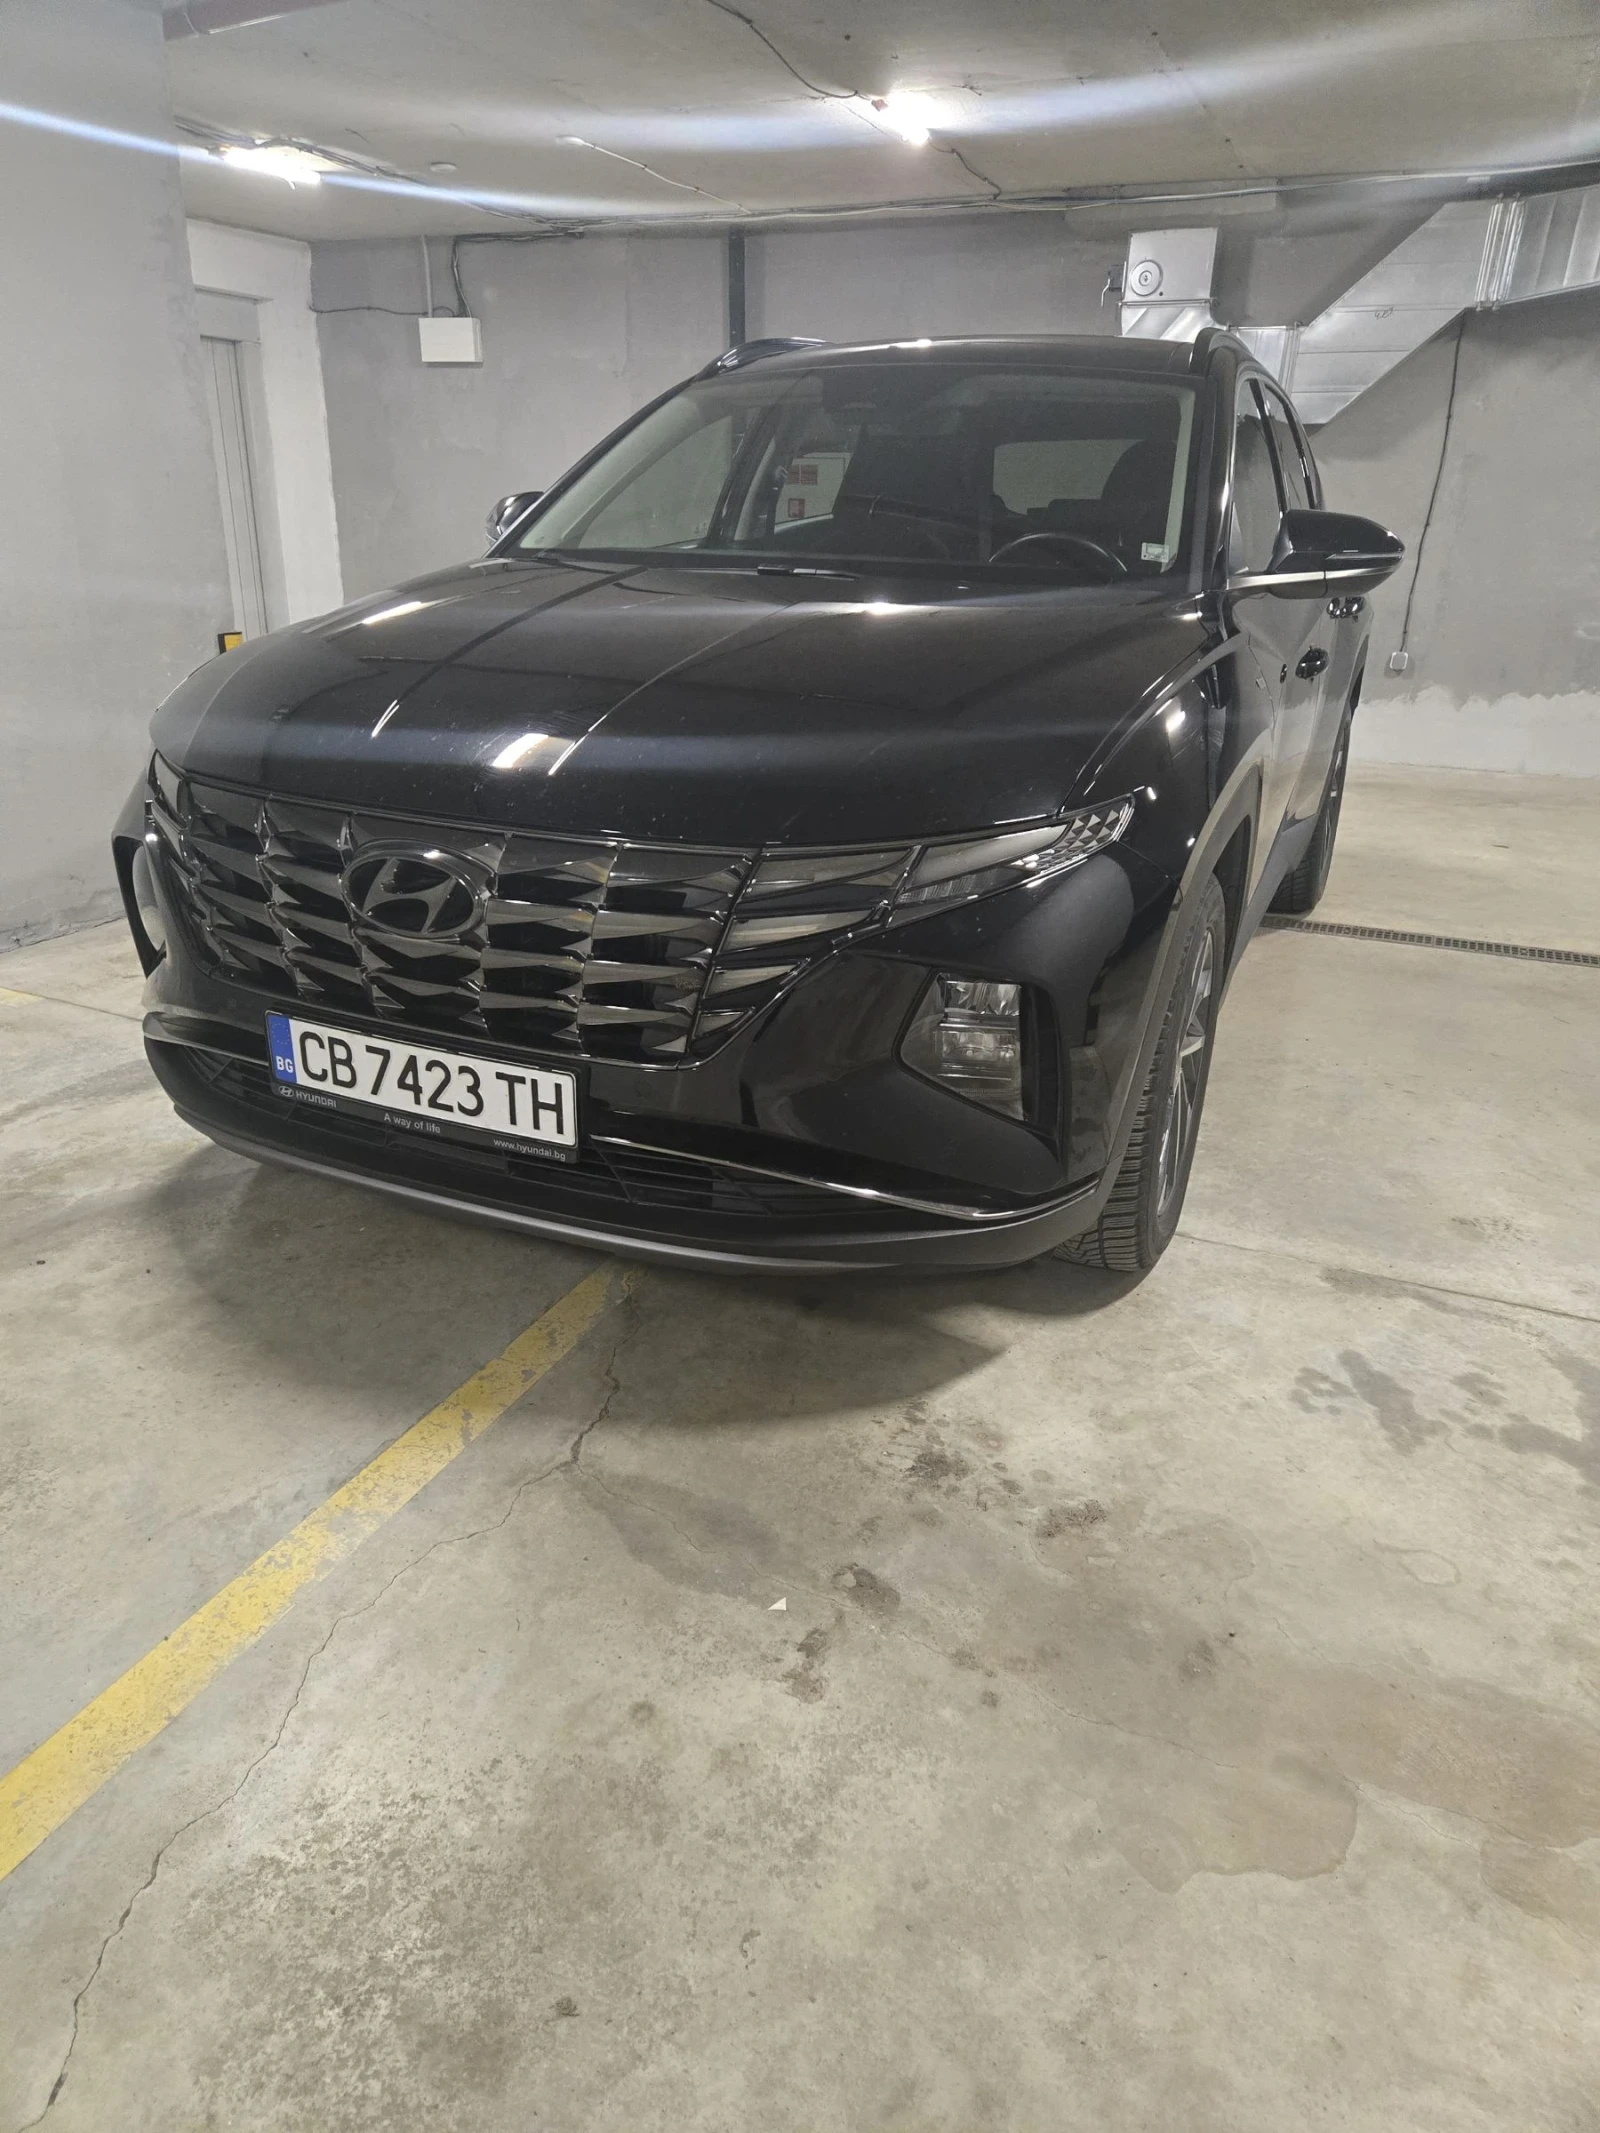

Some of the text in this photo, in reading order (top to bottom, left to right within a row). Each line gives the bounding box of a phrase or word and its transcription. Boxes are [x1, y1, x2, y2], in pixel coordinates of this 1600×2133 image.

[276, 1056, 294, 1074] BG
[299, 1031, 564, 1135] CB 7423 TH
[296, 1090, 337, 1108] HYUNDAI
[383, 1112, 441, 1134] A way of life
[493, 1138, 566, 1162] www.hyundai.bg
